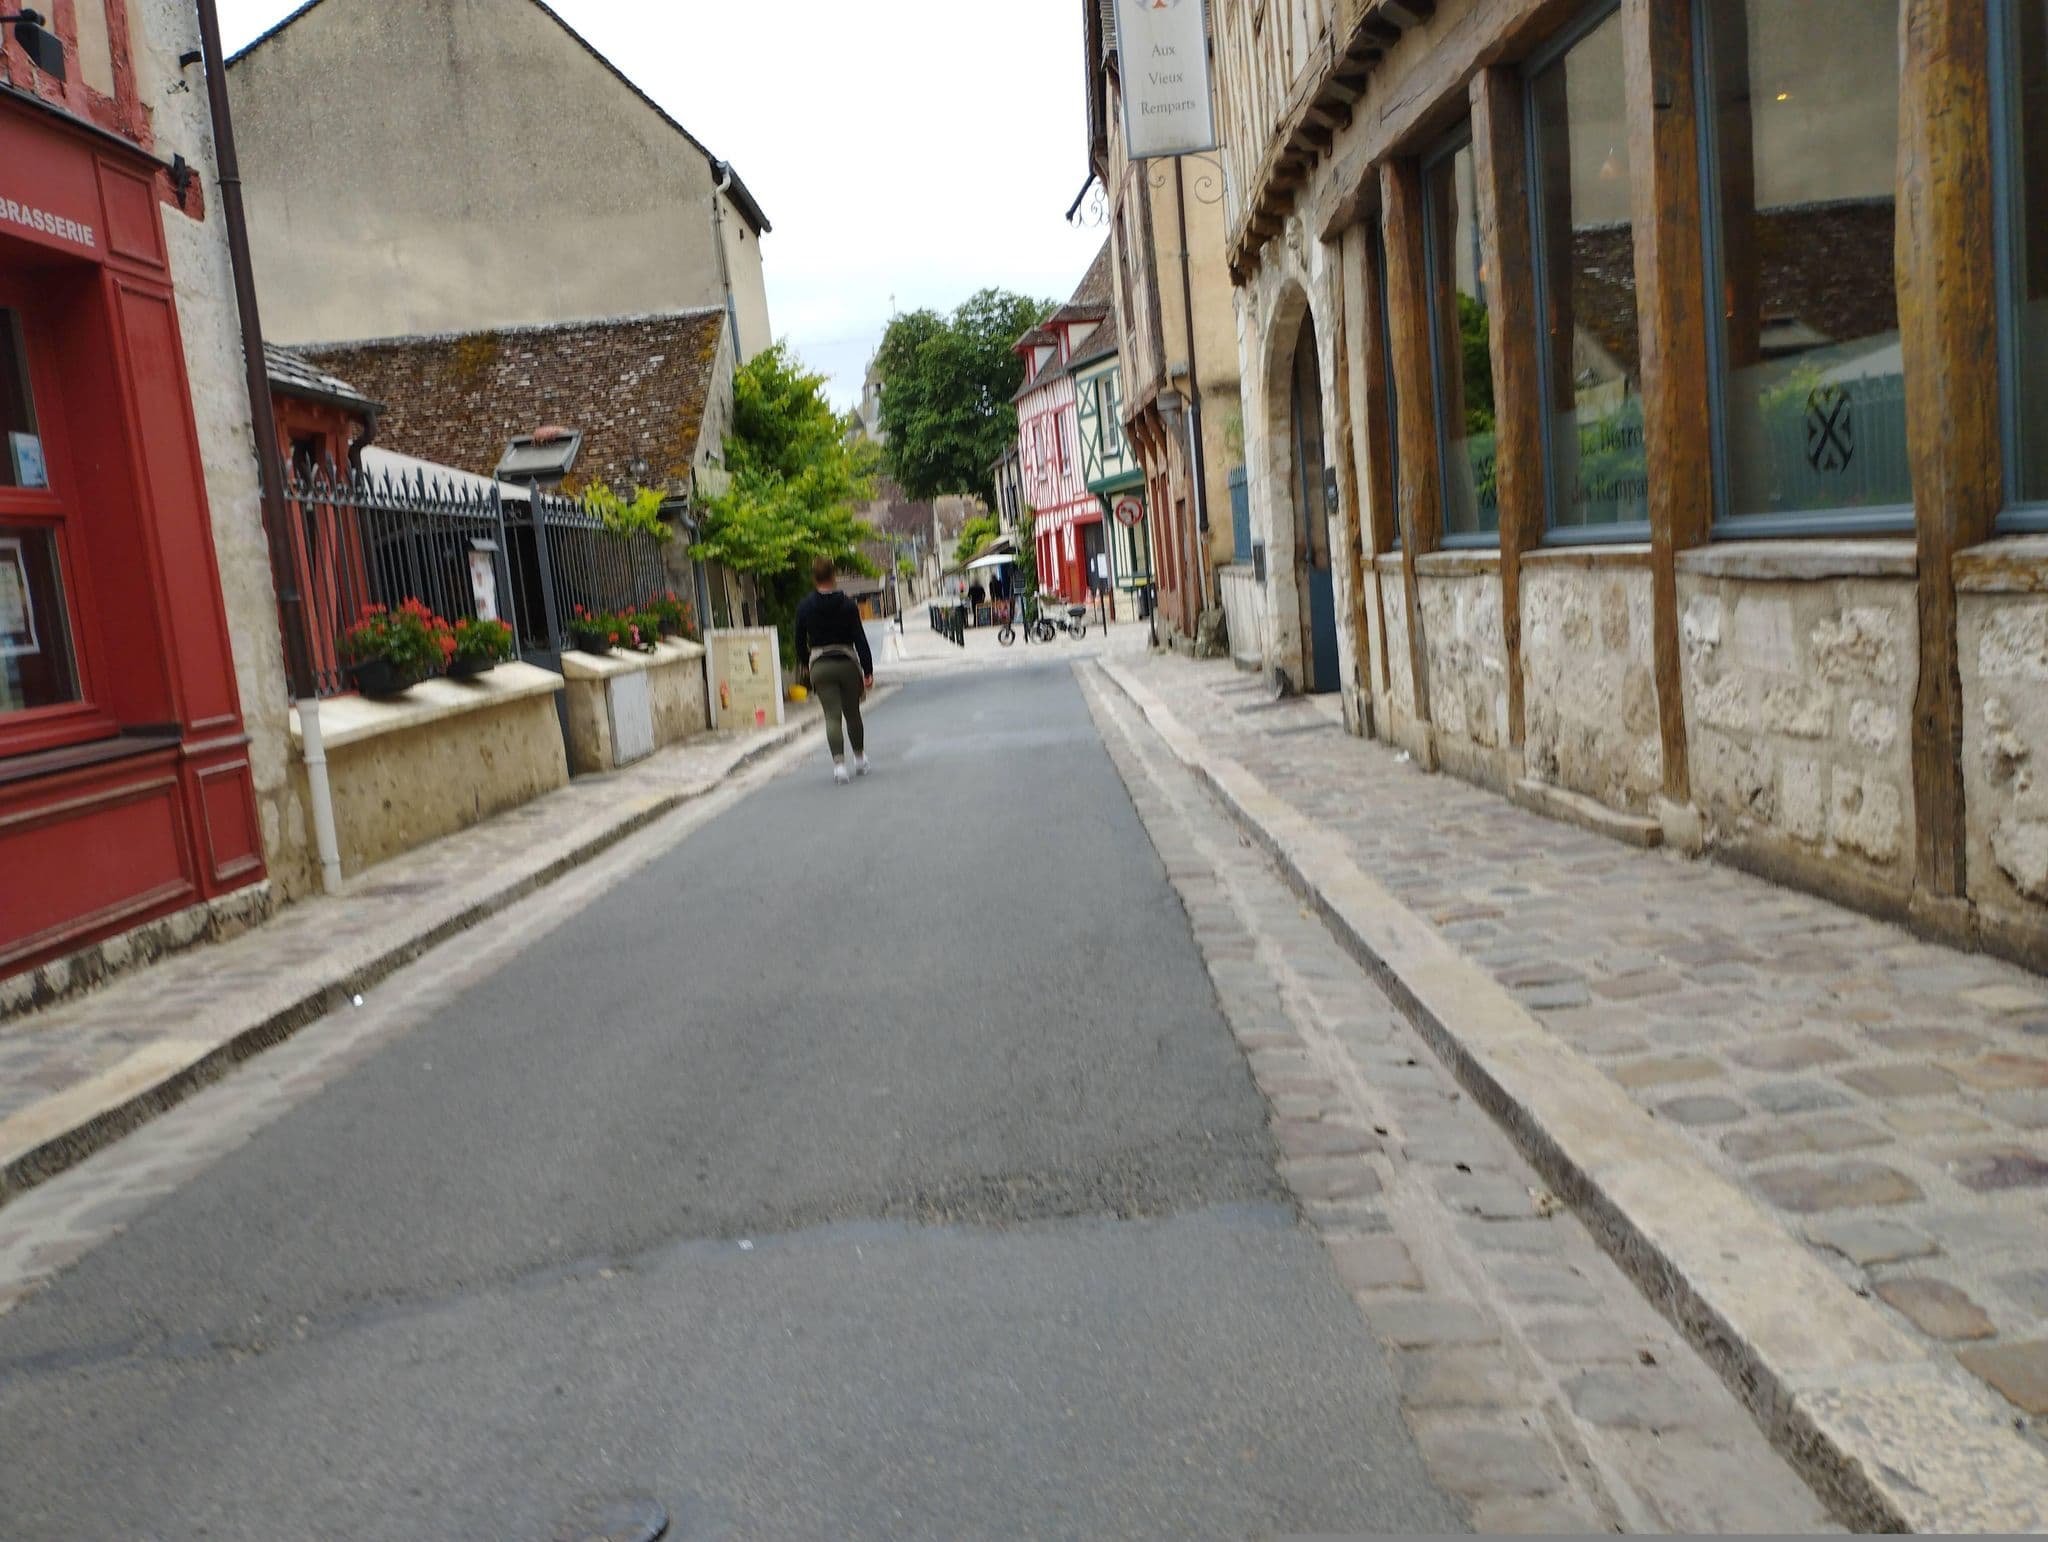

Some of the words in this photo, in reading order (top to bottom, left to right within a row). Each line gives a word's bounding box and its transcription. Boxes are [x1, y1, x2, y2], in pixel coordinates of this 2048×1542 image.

[1152, 43, 1176, 58] Aux
[1148, 72, 1184, 86] Vieux
[1141, 99, 1196, 115] Remparts
[0, 196, 96, 248] BRASSERIE
